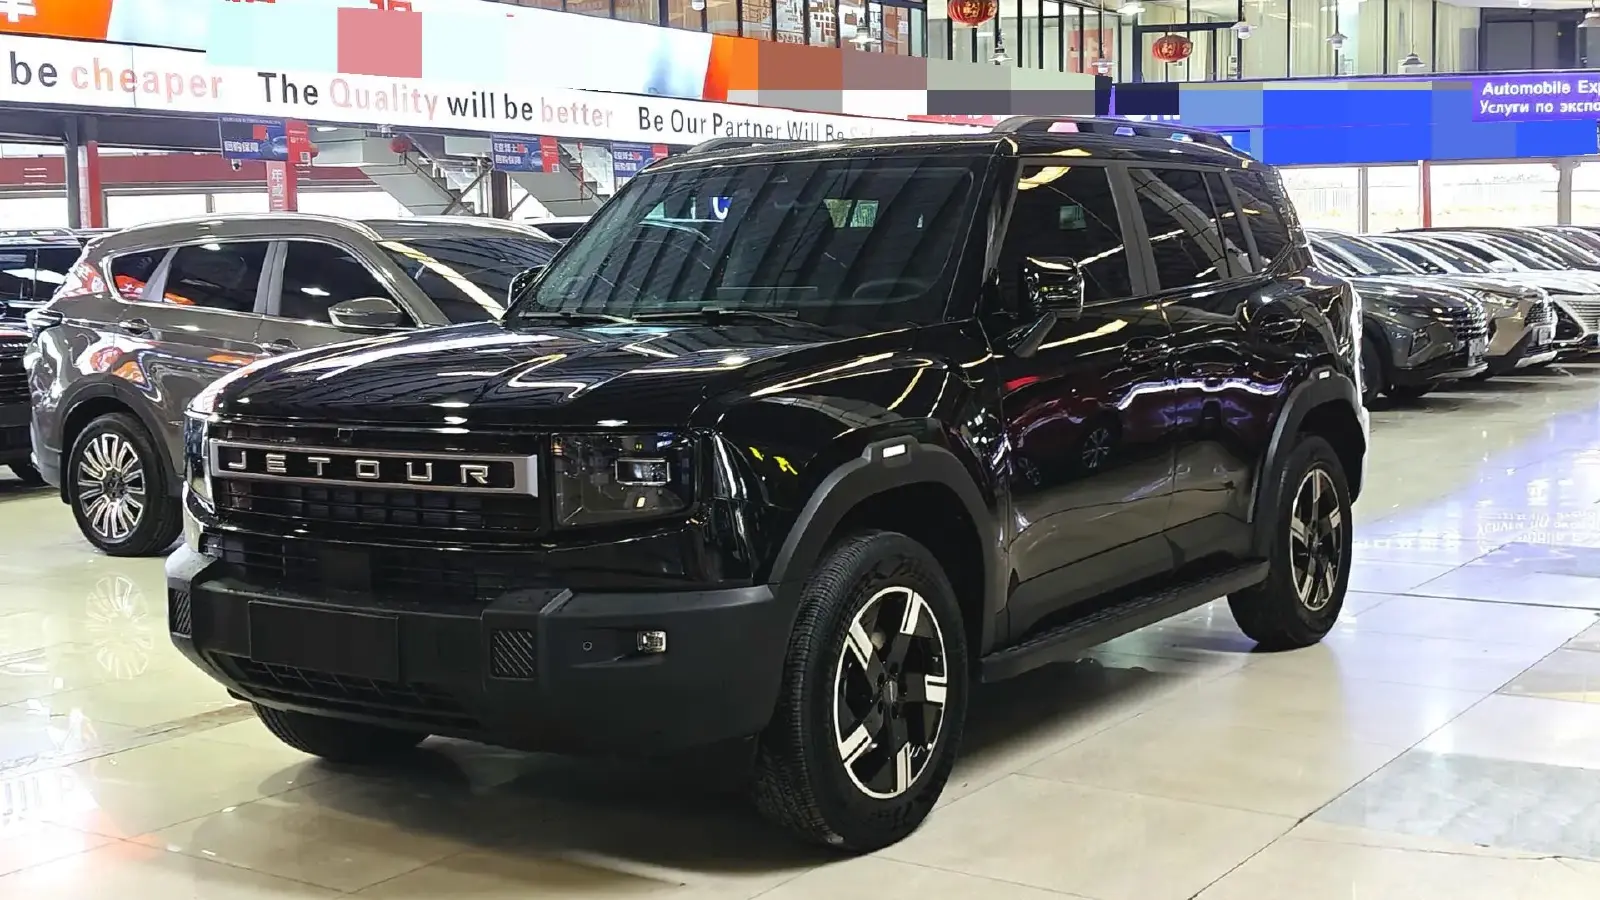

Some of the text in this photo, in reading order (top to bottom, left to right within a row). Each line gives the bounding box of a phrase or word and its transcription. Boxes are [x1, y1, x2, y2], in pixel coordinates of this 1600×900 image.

[10, 51, 57, 87] be
[71, 57, 223, 103] cheaper
[257, 72, 319, 105] The
[329, 78, 438, 121] Quality
[446, 91, 495, 119] will
[504, 93, 533, 121] be
[541, 96, 613, 129] better
[638, 106, 664, 132] Be
[671, 109, 706, 134] Our
[712, 112, 782, 140] Partner
[787, 119, 819, 141] Will
[1482, 80, 1600, 97] Automobile Ex
[1480, 100, 1529, 117] Услуги
[1535, 102, 1554, 112] по
[228, 450, 489, 485] JETOUR
